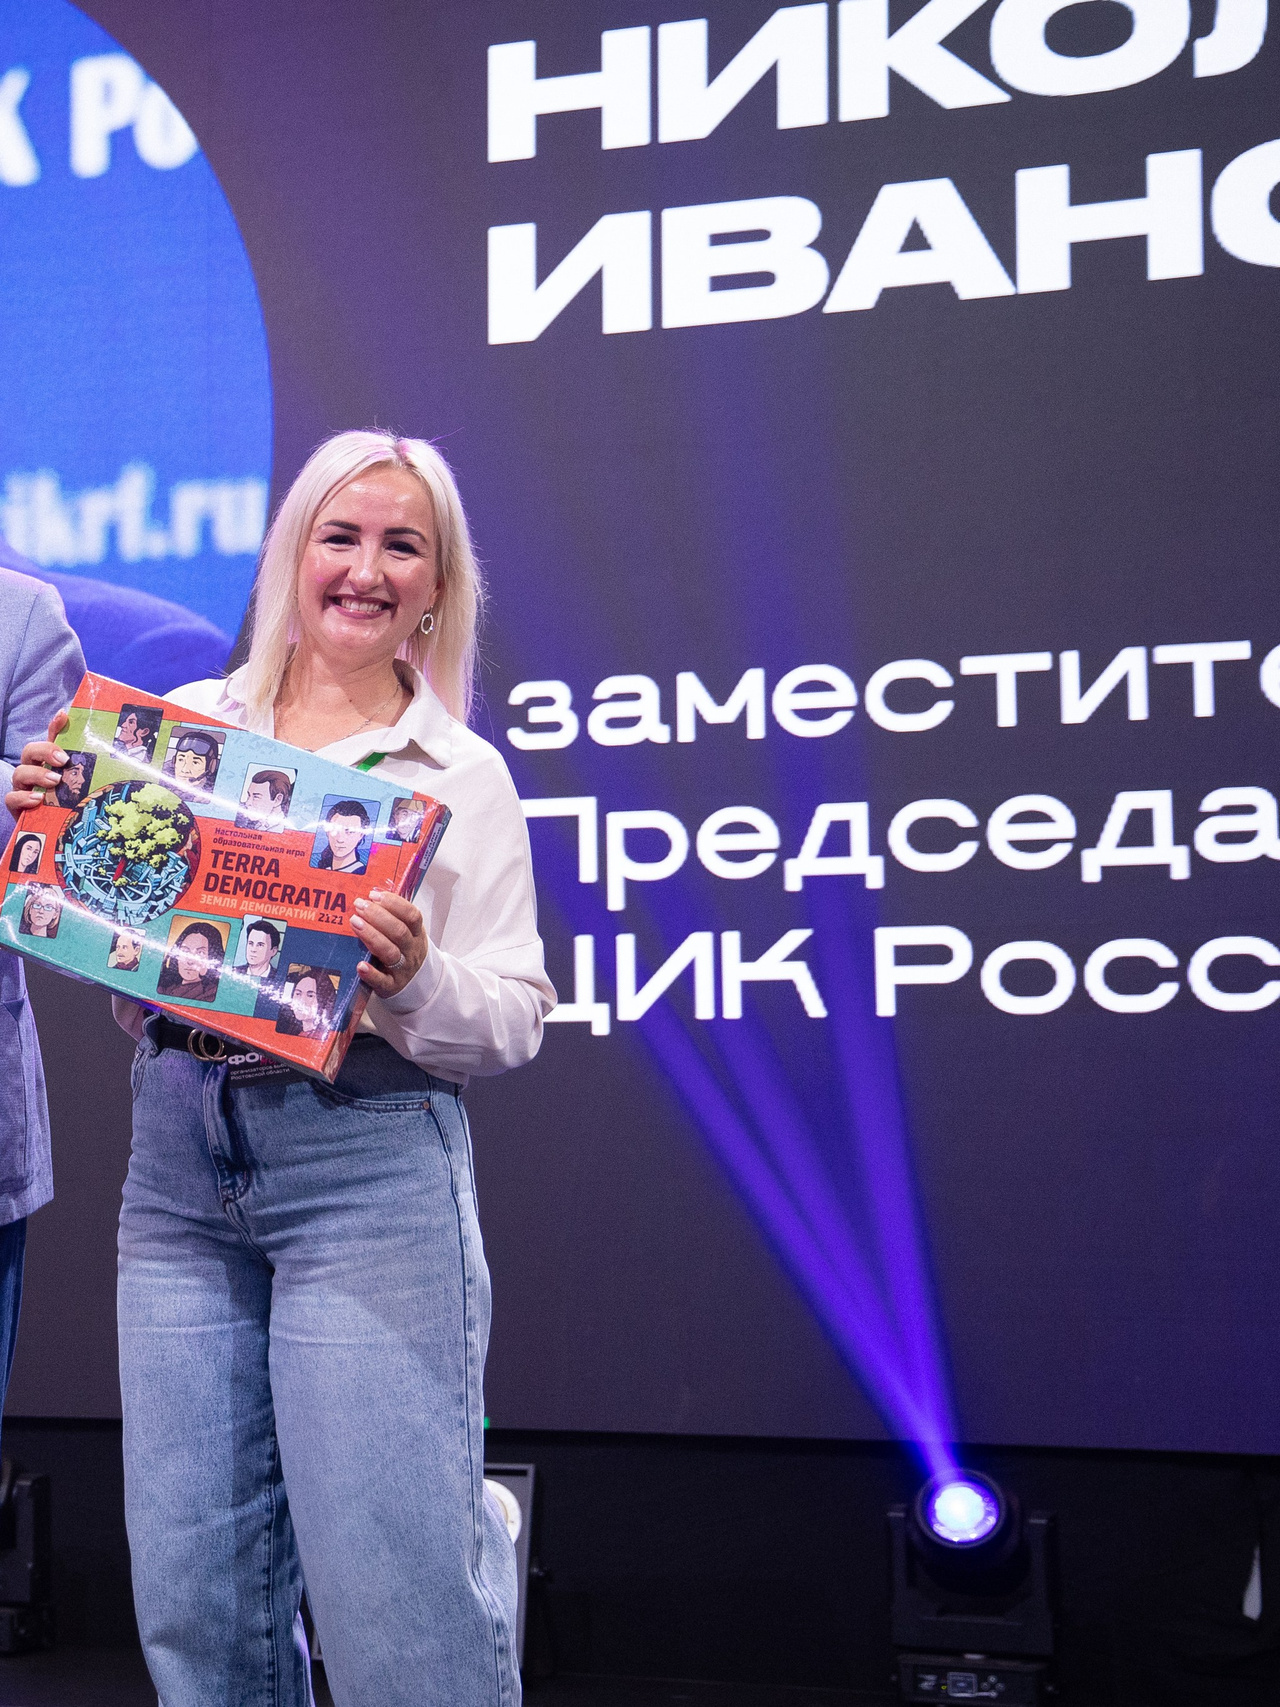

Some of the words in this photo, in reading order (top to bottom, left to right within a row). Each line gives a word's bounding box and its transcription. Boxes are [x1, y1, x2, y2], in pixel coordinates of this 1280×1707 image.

[507, 639, 1280, 750] заместит
[212, 836, 285, 854] образовательная
[286, 849, 306, 858] игра
[214, 827, 263, 841] Настольная
[210, 849, 280, 878] TERRA
[203, 872, 347, 913] DEMOCRATIA
[200, 893, 238, 909] ЗЕМЛЯ
[239, 899, 317, 922] ДЕМОКРАТИЙ
[317, 912, 345, 926] 2121
[874, 925, 1280, 1017] Росс
[228, 1052, 263, 1065] ФО
